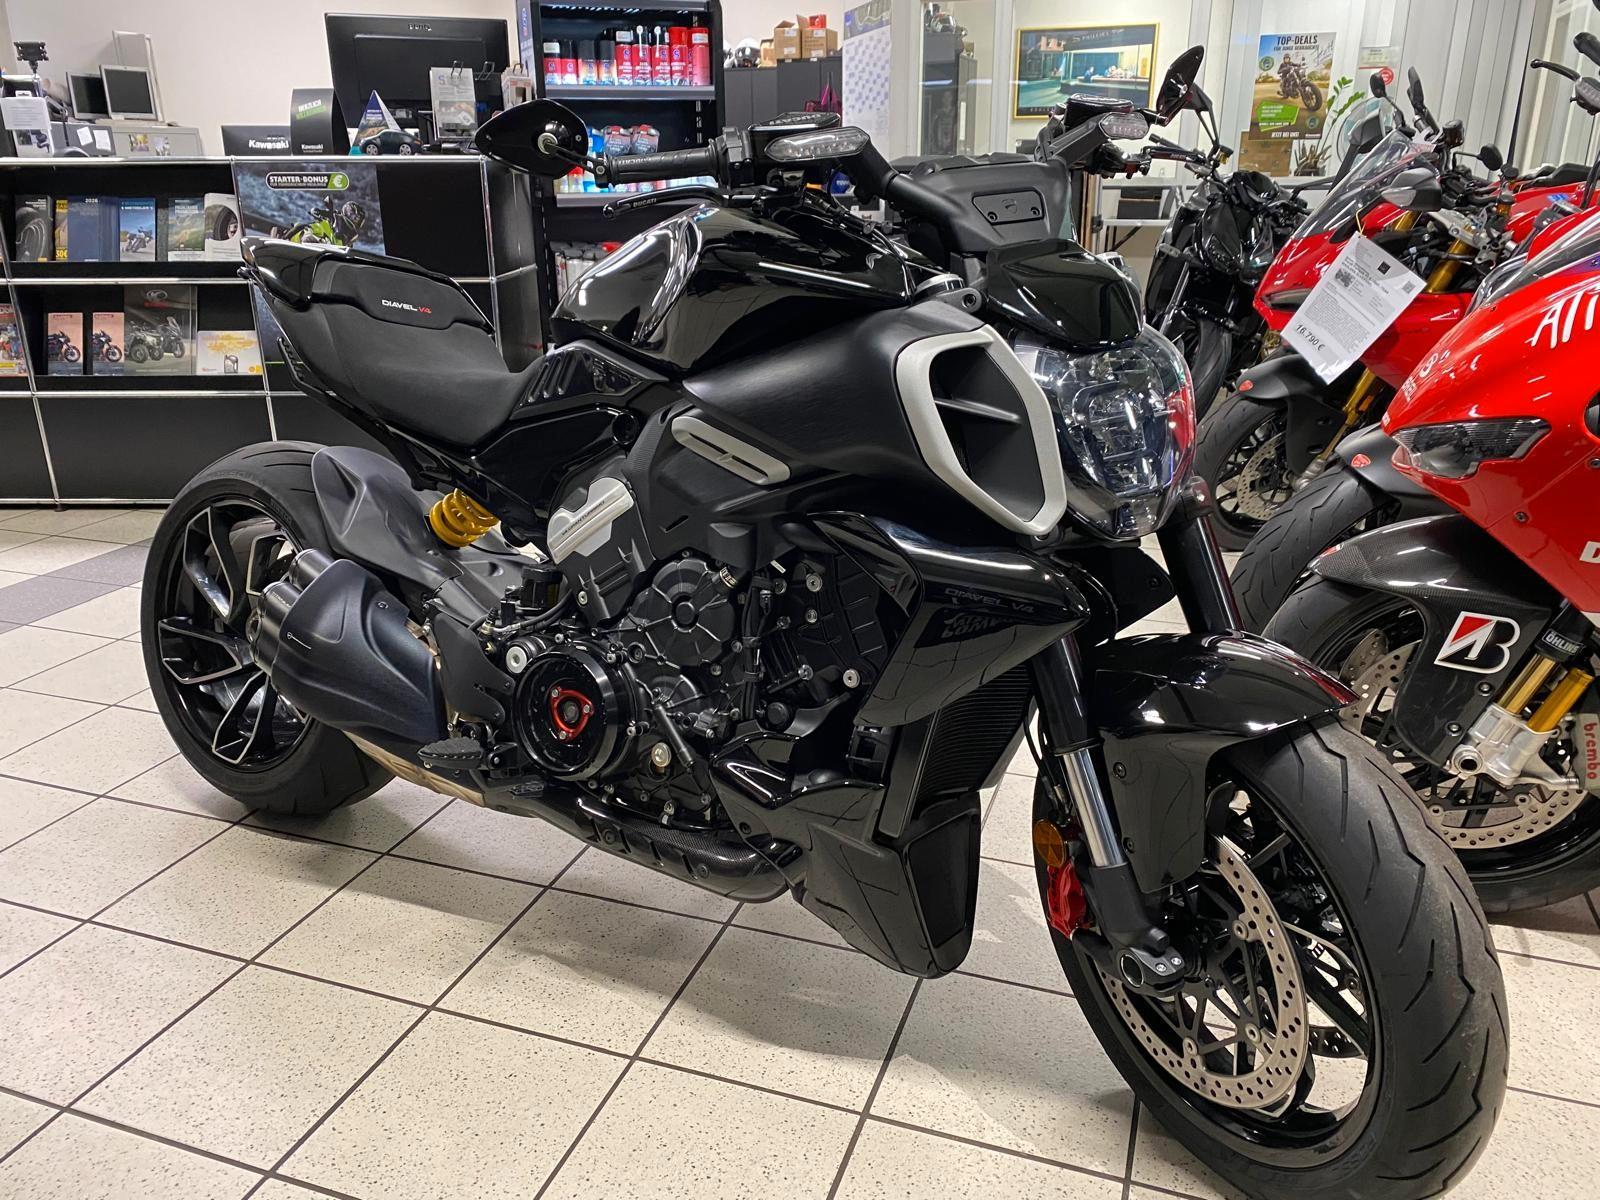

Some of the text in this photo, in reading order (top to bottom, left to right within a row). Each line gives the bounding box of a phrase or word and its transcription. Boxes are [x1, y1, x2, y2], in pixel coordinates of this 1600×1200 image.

[1277, 34, 1318, 46] TOP-DEALS
[248, 139, 290, 150] Kawasaki
[633, 198, 657, 208] DUCATI
[381, 299, 433, 314] DIAVEL V4
[1295, 323, 1320, 347] 16.790
[944, 587, 1035, 614] DIAVEL V4
[1582, 721, 1598, 781] brembo
